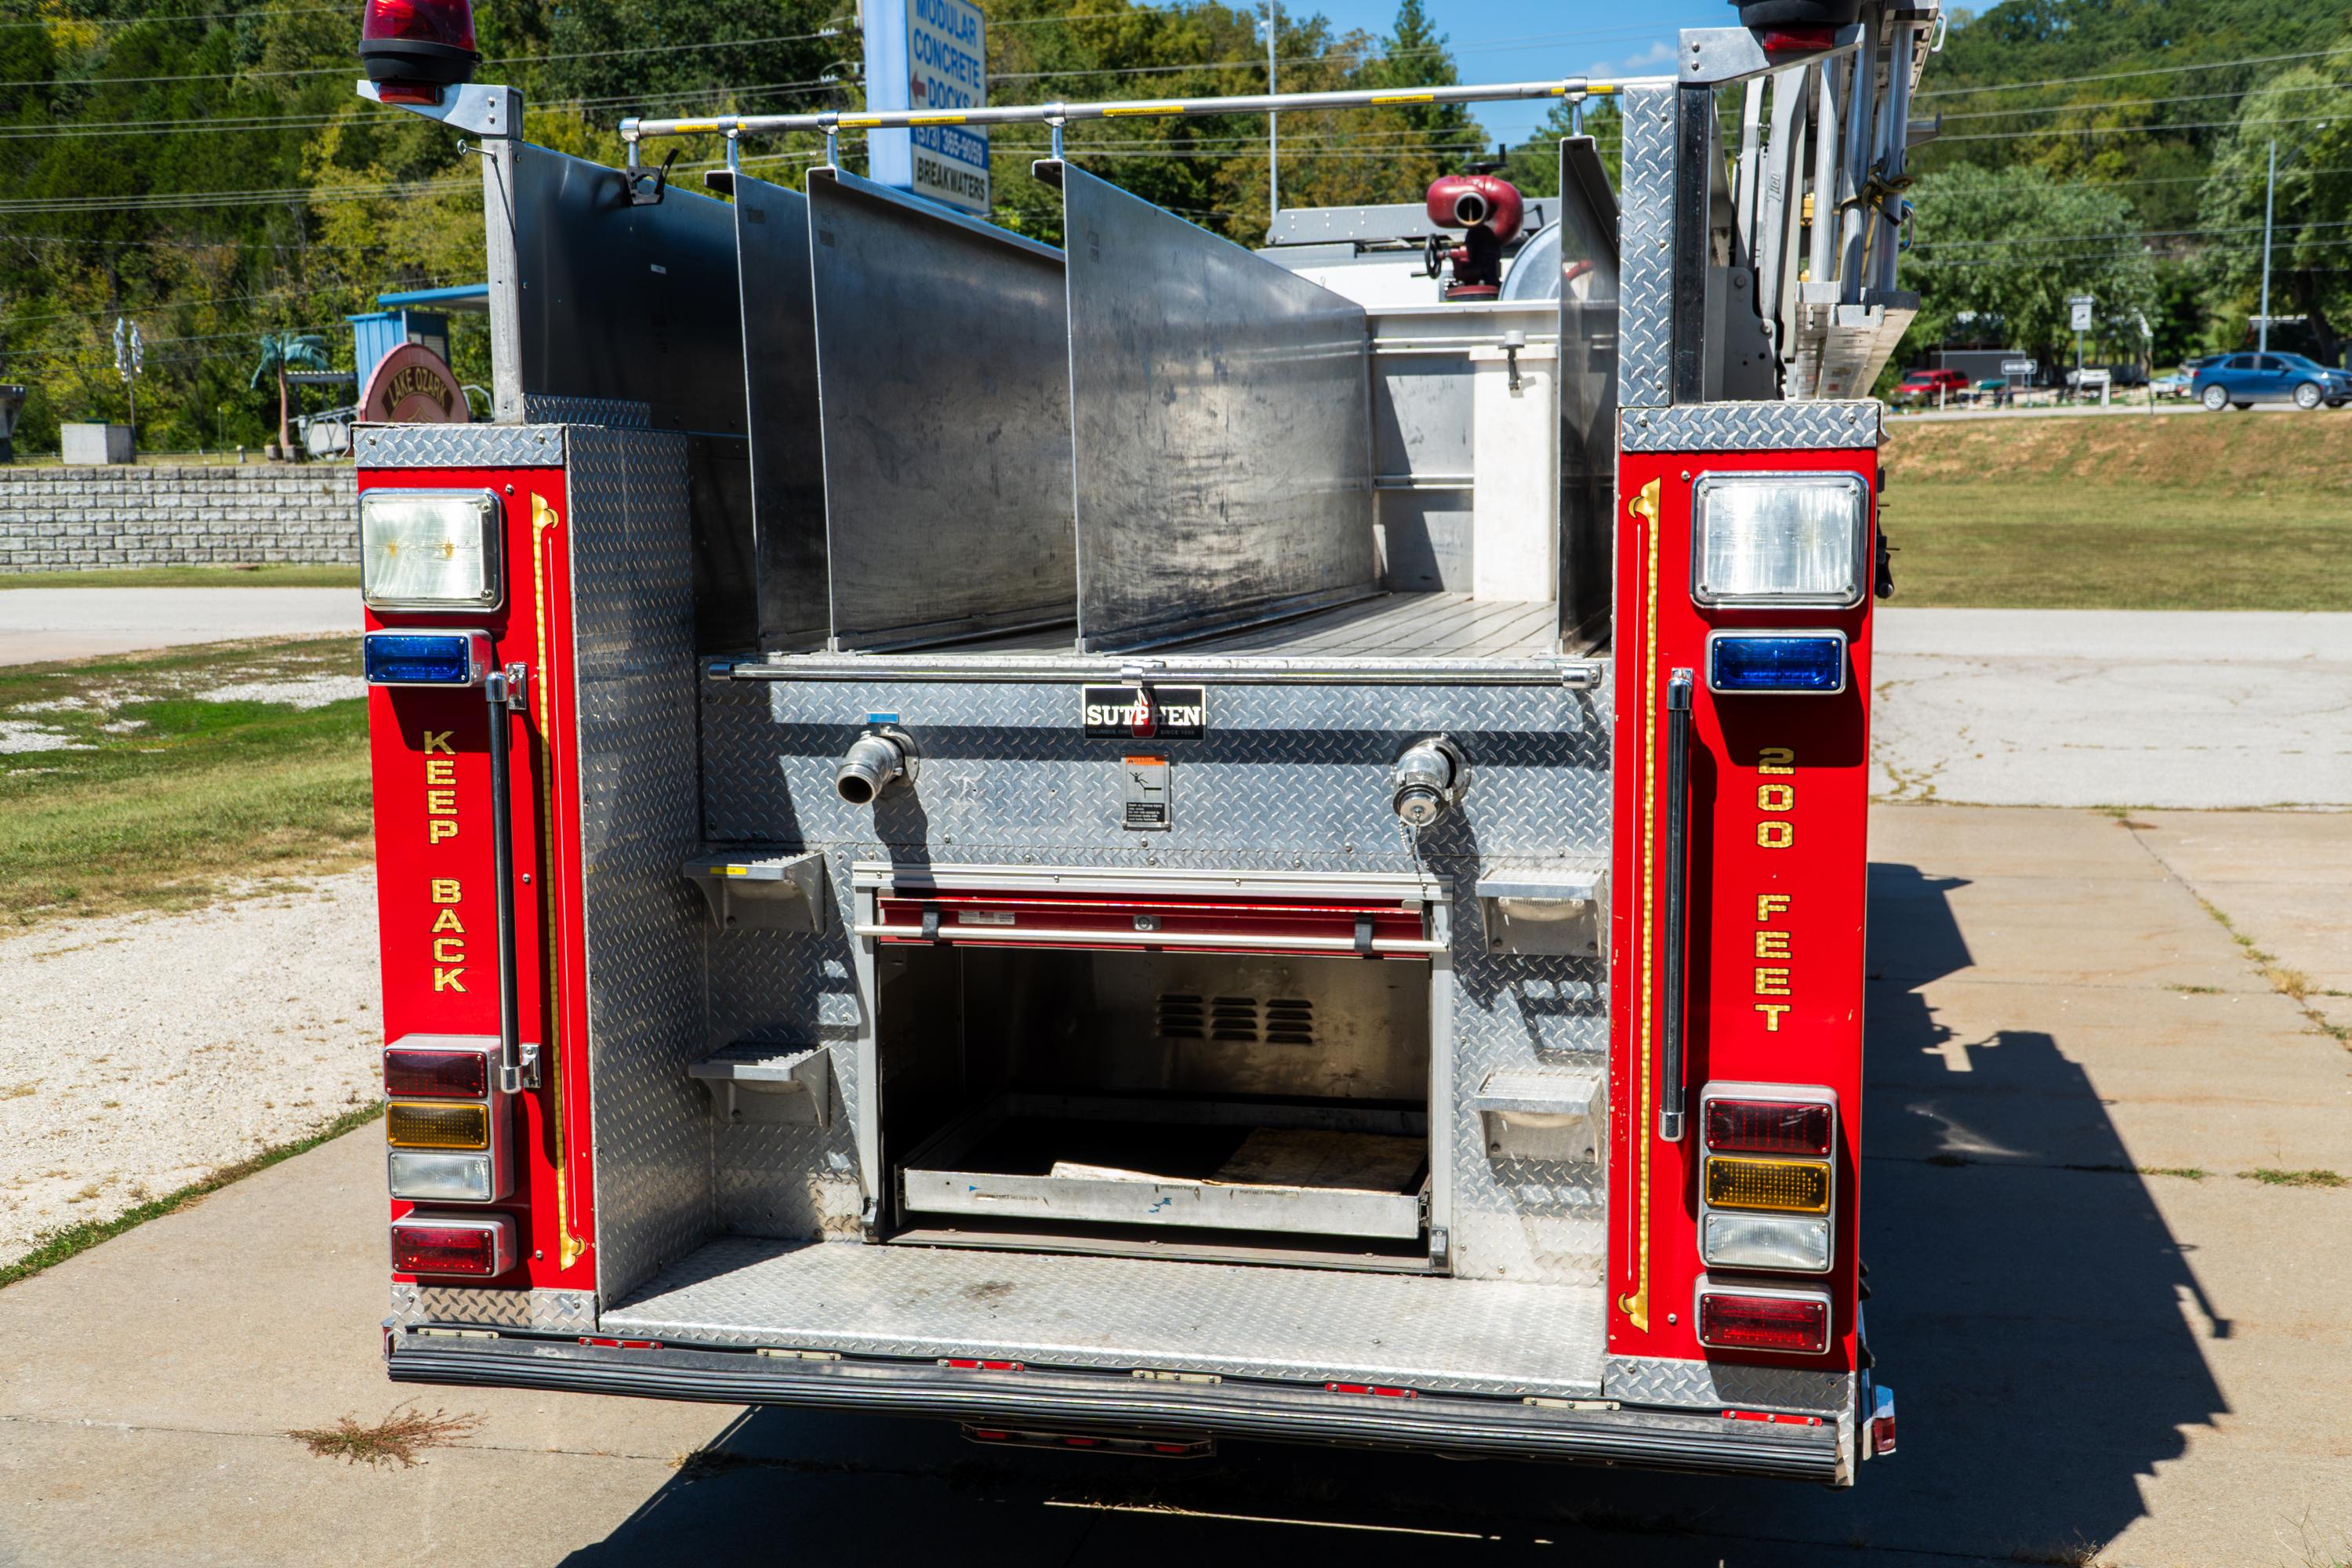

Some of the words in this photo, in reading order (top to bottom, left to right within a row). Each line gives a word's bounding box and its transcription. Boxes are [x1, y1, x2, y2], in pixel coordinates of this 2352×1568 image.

[916, 0, 977, 49] MODULAR
[914, 28, 981, 89] CONCRETE
[928, 77, 971, 109] DOCKS
[917, 157, 985, 202] BREAKWATERS
[388, 368, 414, 407] LAKE
[415, 367, 448, 407] OZARK
[1087, 704, 1201, 726] SUTPHEN
[423, 730, 459, 844] KEEP
[1755, 747, 1795, 849] 200
[430, 878, 468, 993] BACK
[1753, 894, 1792, 1032] FEET
